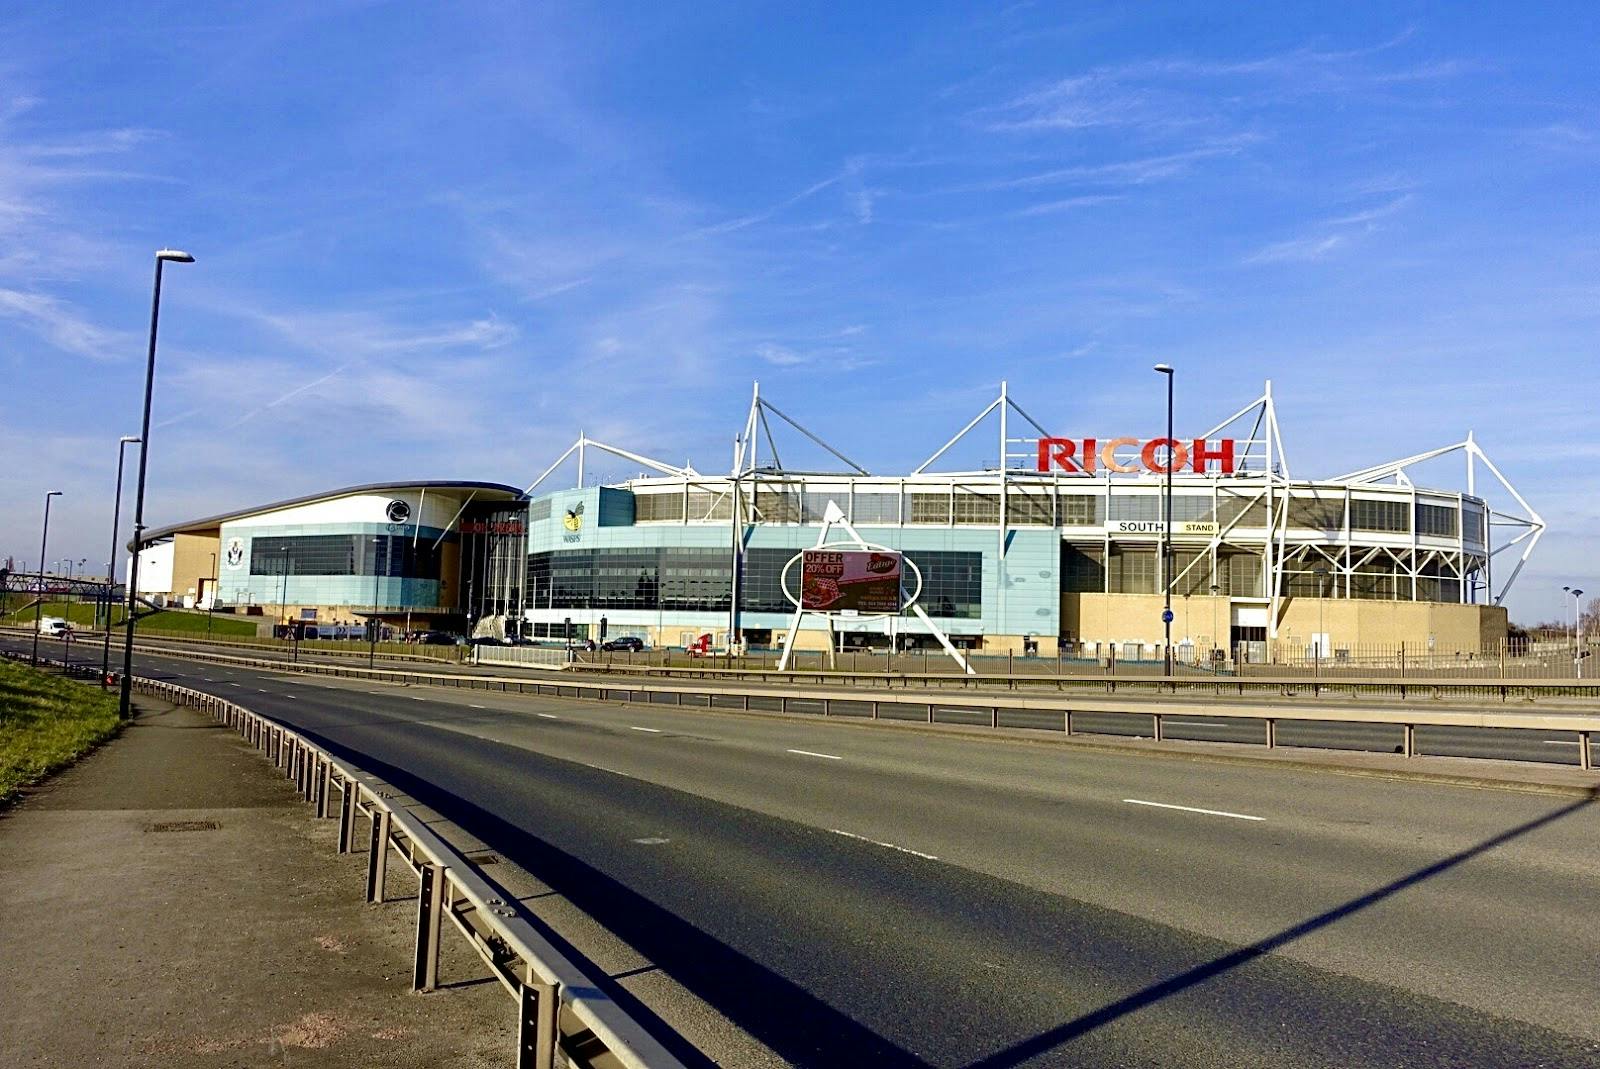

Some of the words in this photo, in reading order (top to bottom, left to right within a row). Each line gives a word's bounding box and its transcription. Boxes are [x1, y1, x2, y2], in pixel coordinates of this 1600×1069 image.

[1038, 437, 1235, 474] RICOH
[1119, 522, 1164, 532] SOUTH
[1185, 524, 1214, 532] STAND
[806, 552, 843, 562] OFFER
[806, 564, 824, 573] 20%
[826, 564, 842, 573] OFF
